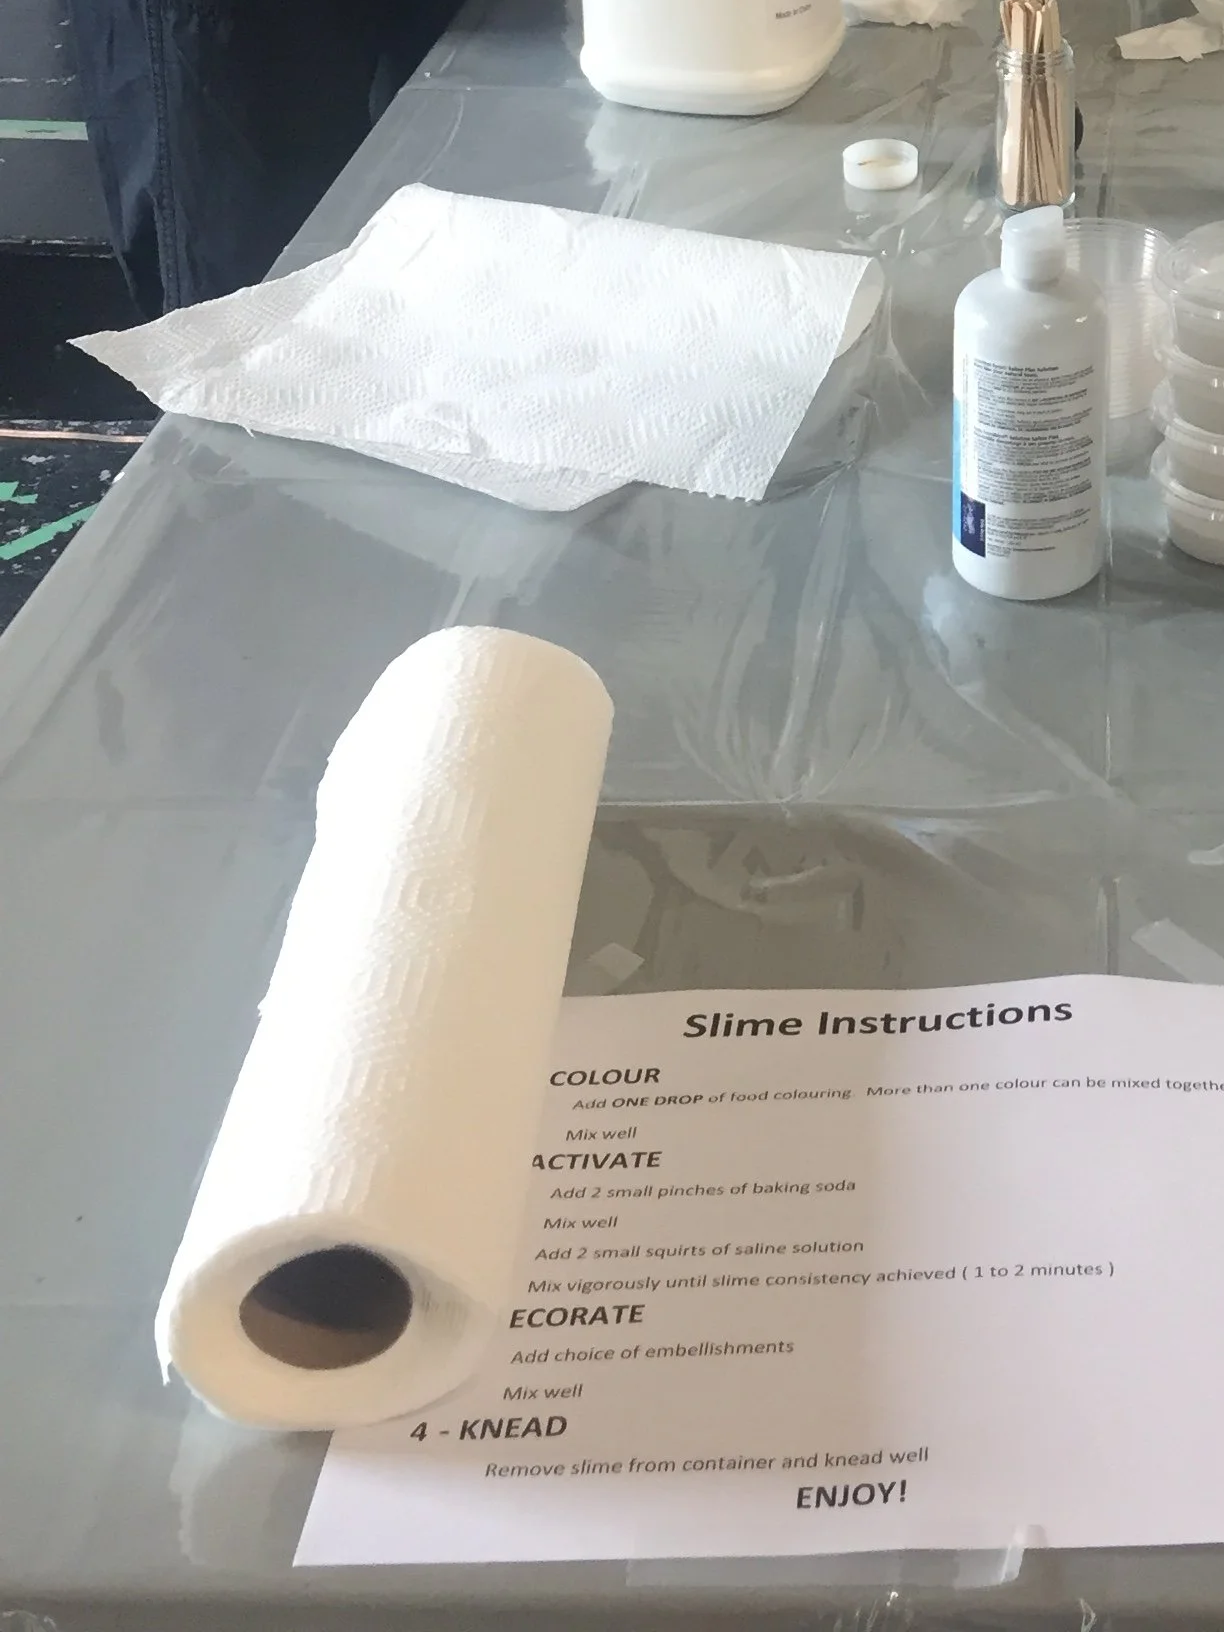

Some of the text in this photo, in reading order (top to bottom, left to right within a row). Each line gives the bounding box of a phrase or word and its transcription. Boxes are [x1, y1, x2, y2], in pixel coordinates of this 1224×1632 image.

[682, 1002, 1073, 1039] Slime Instructions
[549, 1066, 661, 1087] COLOUR
[571, 1098, 607, 1111] Add
[611, 1096, 650, 1109] ONE
[653, 1094, 704, 1106] DROP
[707, 1091, 727, 1105] of
[730, 1090, 769, 1103] food
[866, 1086, 912, 1097] More
[916, 1083, 954, 1095] than
[958, 1082, 990, 1092] one
[995, 1077, 1048, 1090] colour
[1052, 1078, 1081, 1088] can
[1086, 1075, 1107, 1089] be
[1111, 1077, 1161, 1089] mixed
[565, 1126, 638, 1142] Mix well
[531, 1150, 663, 1171] ACTIVATE
[549, 1179, 856, 1200] Add 2 small pinches of baking soda
[543, 1215, 619, 1230] Mix well
[534, 1241, 864, 1262] Add 2 small squirts of saline solution
[527, 1261, 1115, 1295] Mix vigorously until slime consistency achieved ( 1 to 2 minutes )
[508, 1303, 646, 1330] ECORATE
[509, 1340, 795, 1365] Add choice of embellishments
[502, 1383, 584, 1402] Mix well
[409, 1421, 428, 1442] 4
[458, 1415, 568, 1441] KNEAD
[484, 1445, 929, 1478] Remove slime from container and knead well
[796, 1478, 907, 1511] ENJOY!
